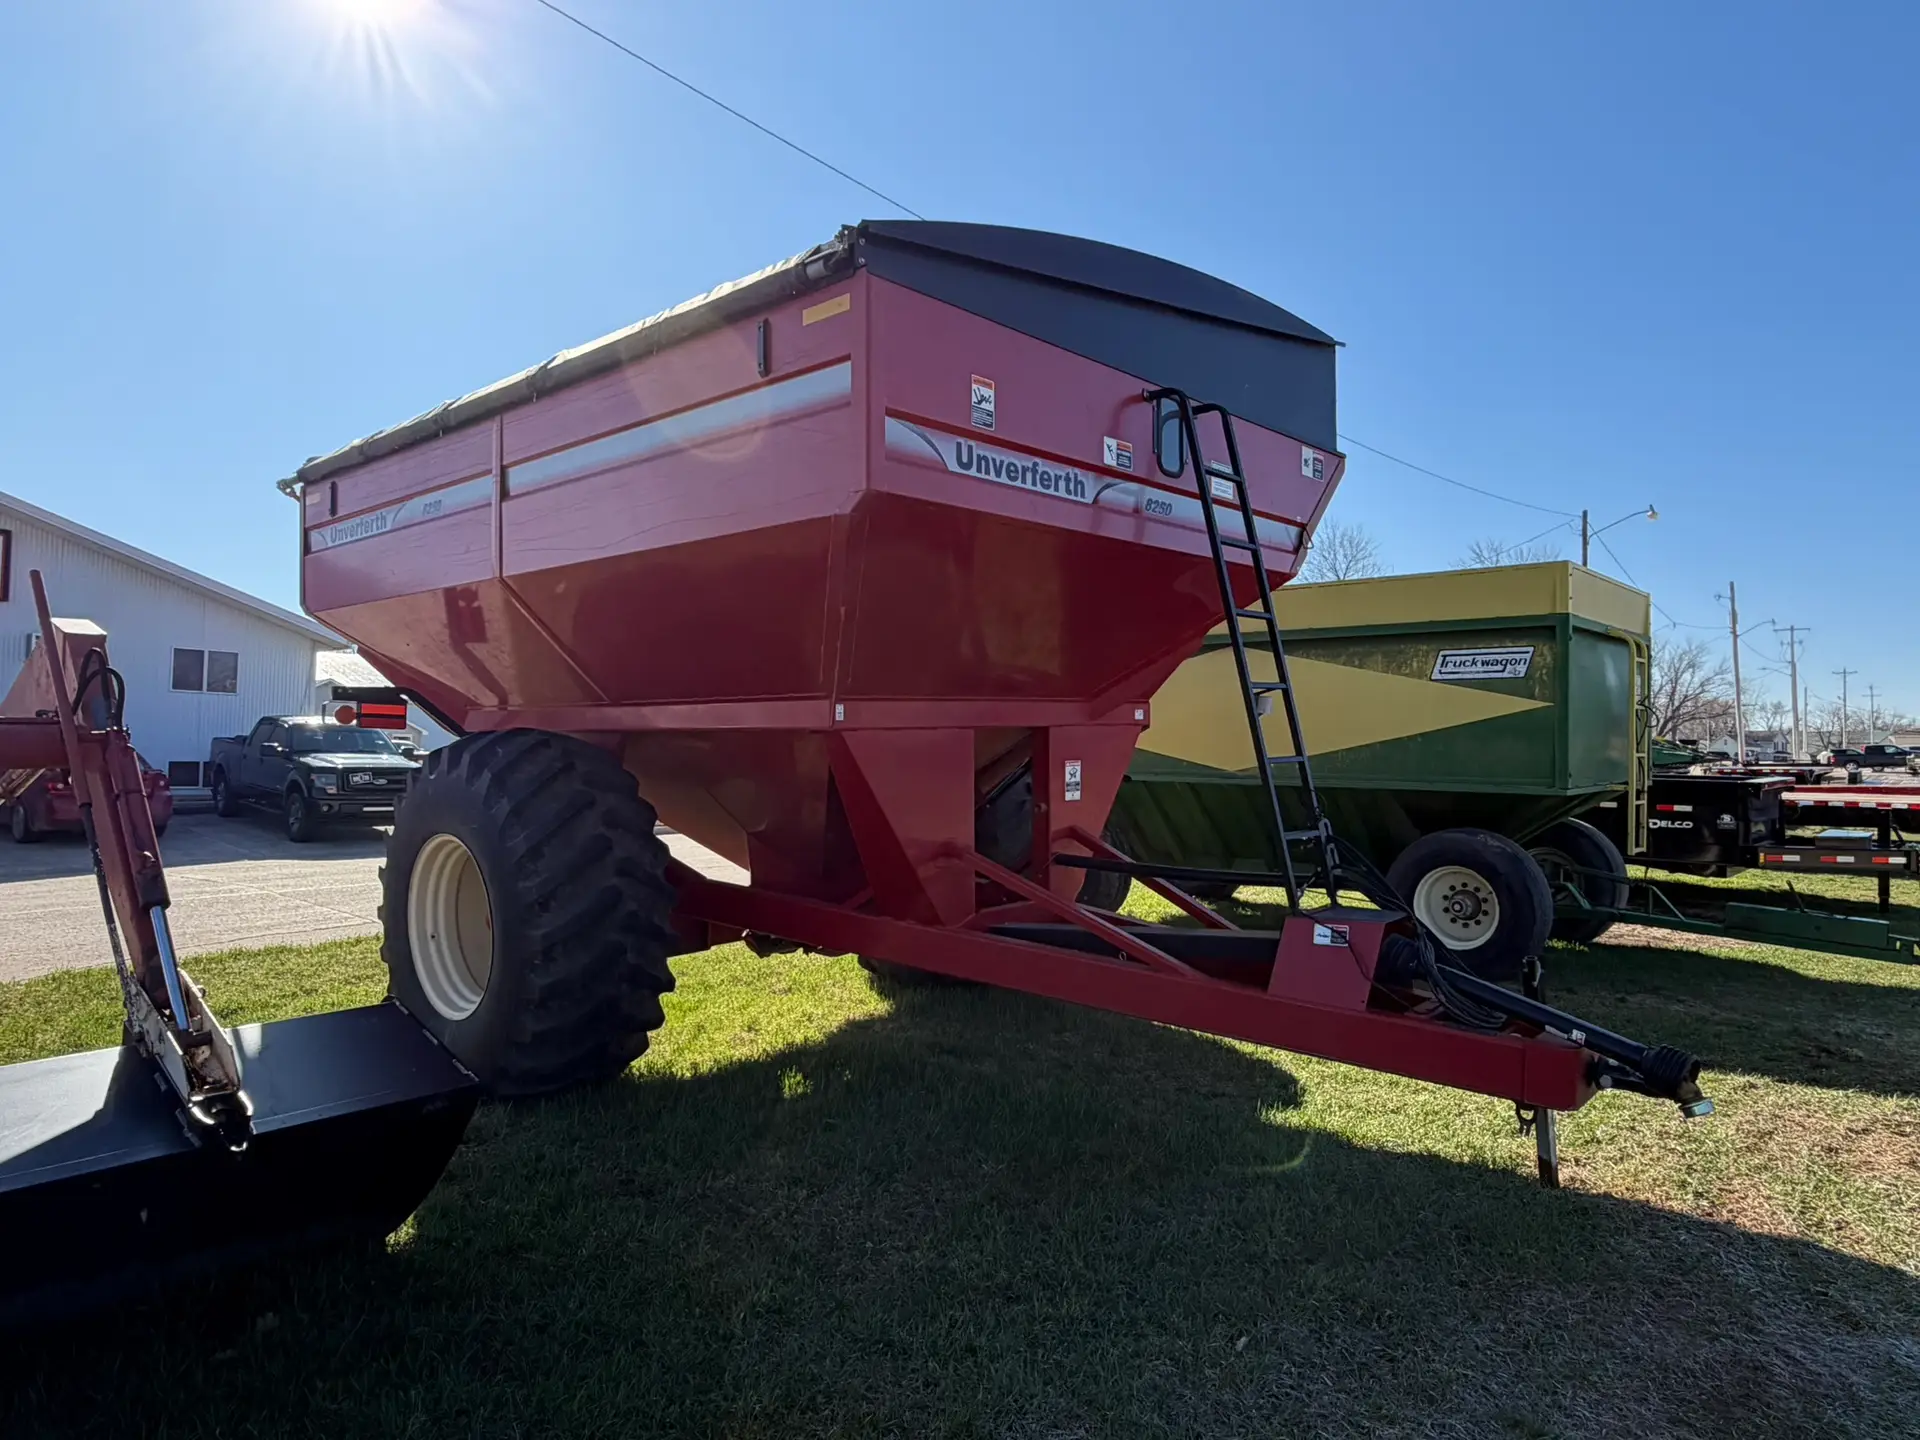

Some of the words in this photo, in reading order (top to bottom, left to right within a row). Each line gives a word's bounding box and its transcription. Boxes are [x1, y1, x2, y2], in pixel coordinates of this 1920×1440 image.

[955, 440, 1087, 500] Unverferth
[1145, 498, 1173, 516] 8250
[330, 511, 388, 544] Unverferth
